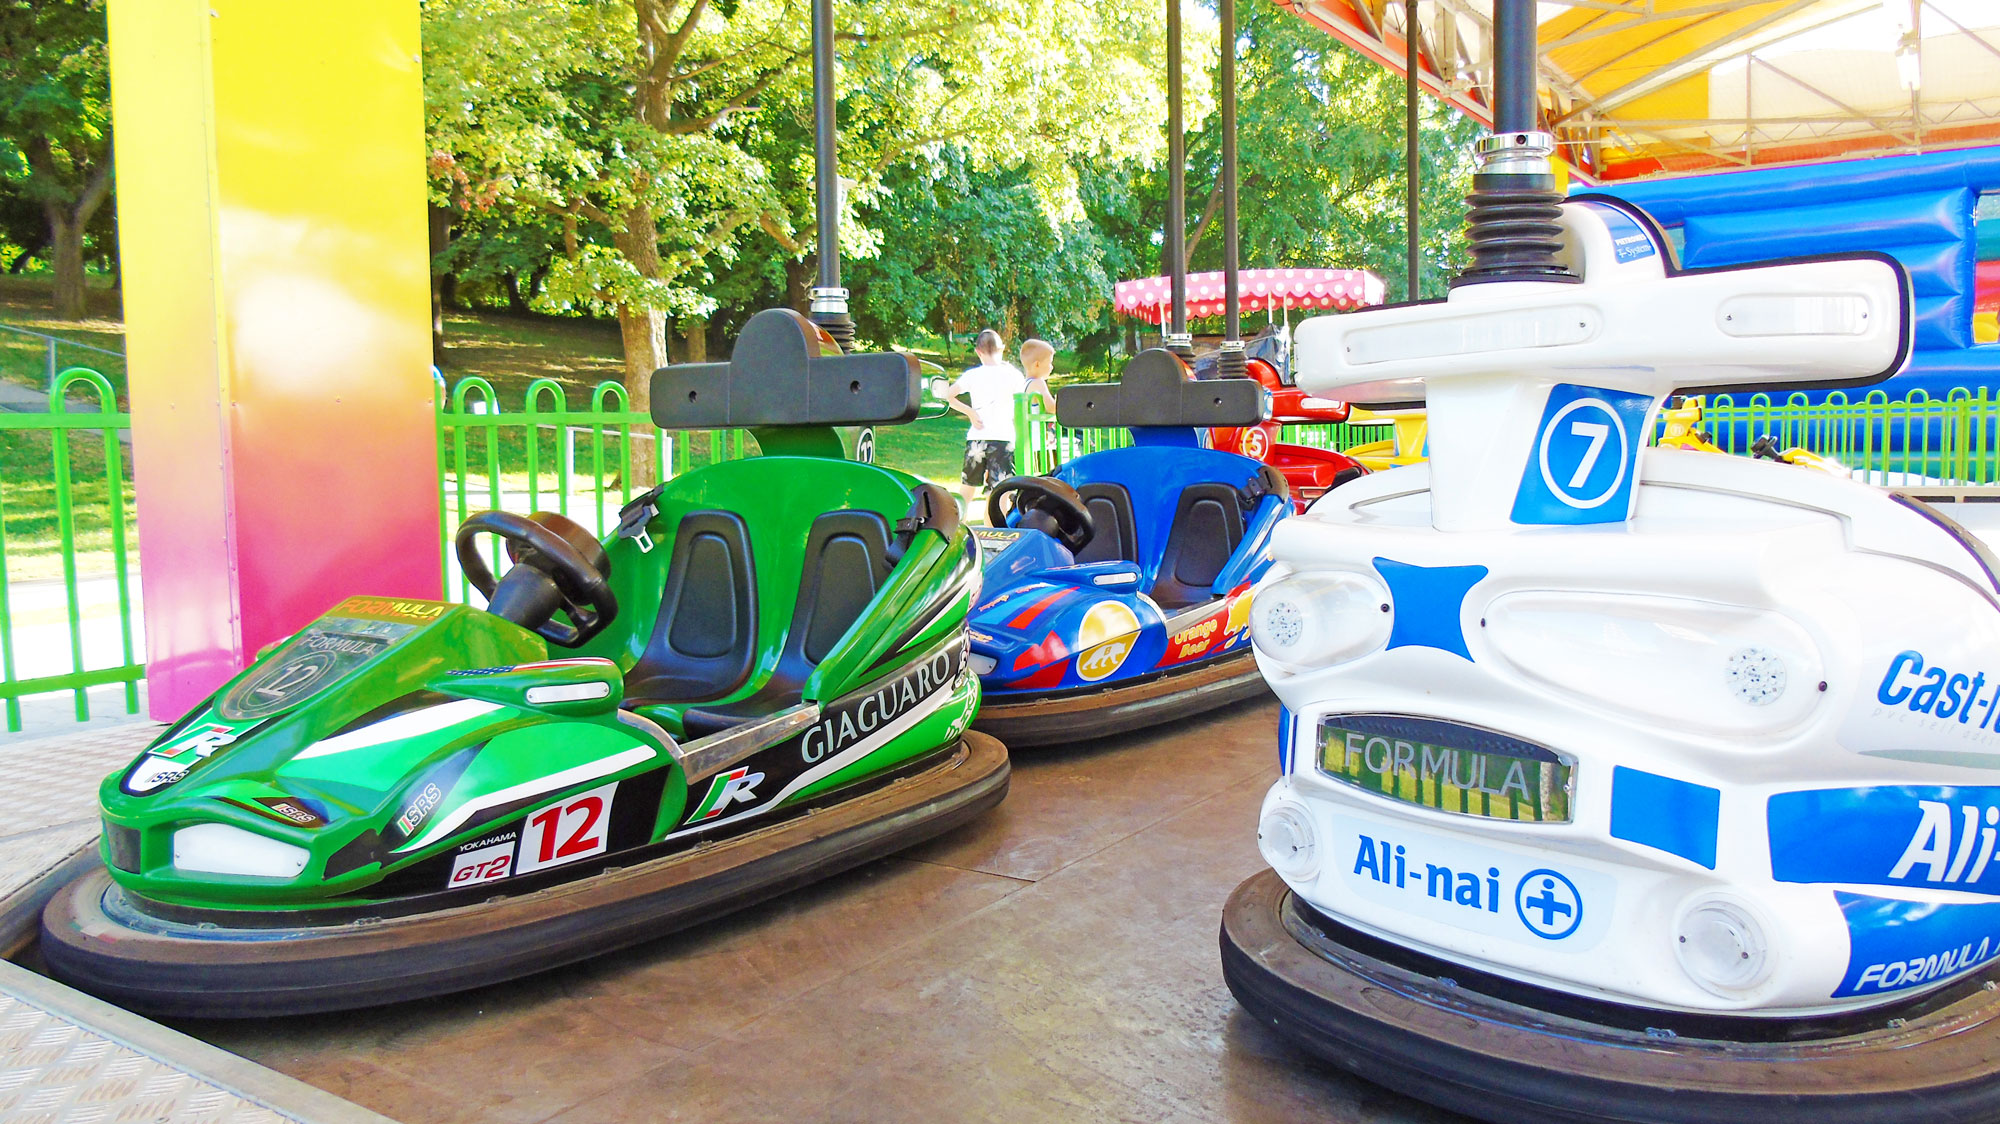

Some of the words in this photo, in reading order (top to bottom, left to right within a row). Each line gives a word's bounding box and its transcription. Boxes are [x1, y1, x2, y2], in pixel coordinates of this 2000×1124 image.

[1249, 433, 1263, 457] 5
[1567, 421, 1609, 489] 7
[338, 599, 446, 617] FORMULA
[300, 635, 378, 656] FORMULA
[1174, 618, 1218, 645] Orange
[256, 663, 319, 696] 12
[801, 650, 951, 763] GIAGUARO
[1344, 732, 1530, 801] FORMULA
[459, 831, 517, 851] YOKAHAMA
[532, 796, 604, 863] 12
[453, 855, 511, 882] GT2
[1353, 834, 1500, 913] Ali-nai
[1853, 936, 1990, 992] FORMULA
